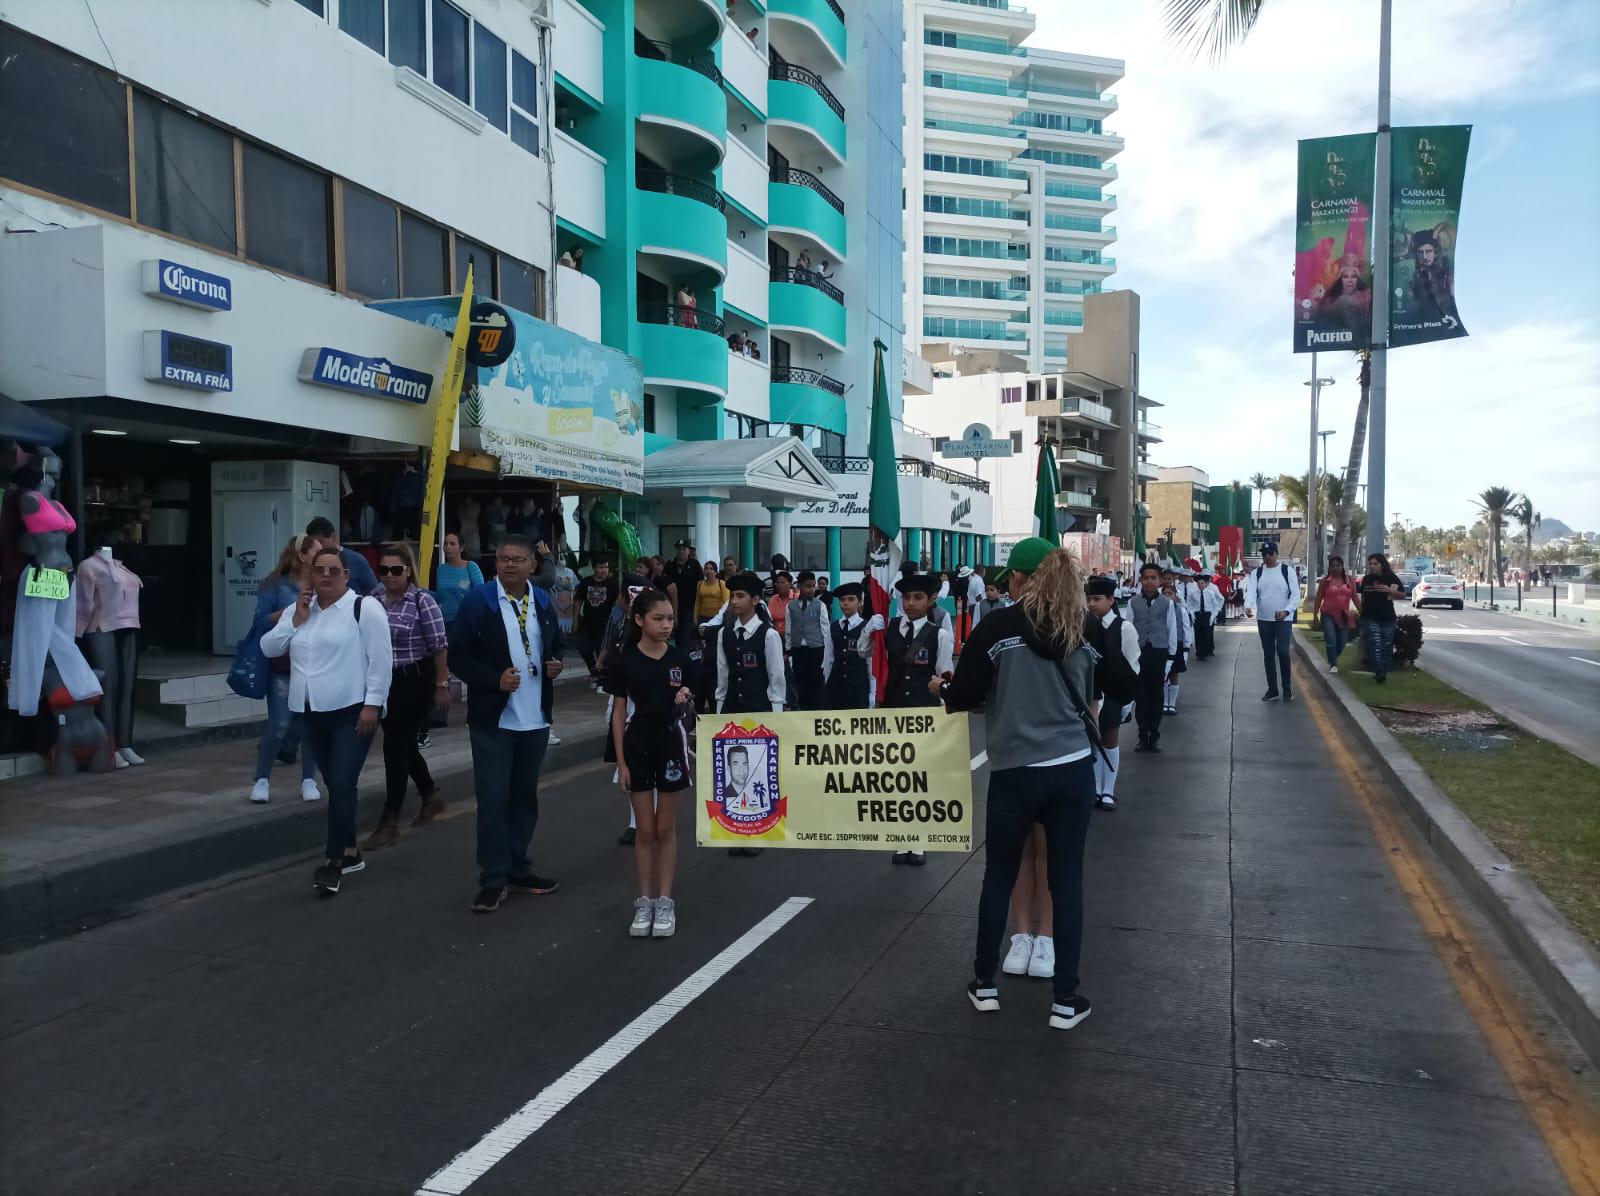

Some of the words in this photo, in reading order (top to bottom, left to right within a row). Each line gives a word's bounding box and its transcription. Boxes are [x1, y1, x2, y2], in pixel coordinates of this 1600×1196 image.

[1311, 196, 1360, 209] CARNAVAL
[1401, 187, 1446, 197] CARNAVAL
[163, 266, 229, 304] Corona
[1307, 329, 1352, 346] PACIFICO
[164, 366, 202, 385] EXTRA
[204, 374, 230, 390] FRÍA
[800, 500, 824, 513] Los
[814, 717, 847, 736] ESC.
[850, 716, 891, 736] PRIM.
[895, 715, 936, 734] VESP.
[794, 742, 917, 766] FRANCISCO
[715, 740, 724, 802] FRANCISCO
[769, 739, 779, 800] ALARCON
[824, 771, 929, 794] ALARCON
[726, 811, 768, 822] FREGOSO
[857, 800, 964, 822] FREGOSO
[796, 832, 818, 841] CLAVE
[819, 833, 835, 841] ESC.
[885, 834, 906, 842] ZONA
[906, 834, 920, 842] 044
[927, 834, 958, 843] SECTOR
[959, 835, 970, 843] XIX
